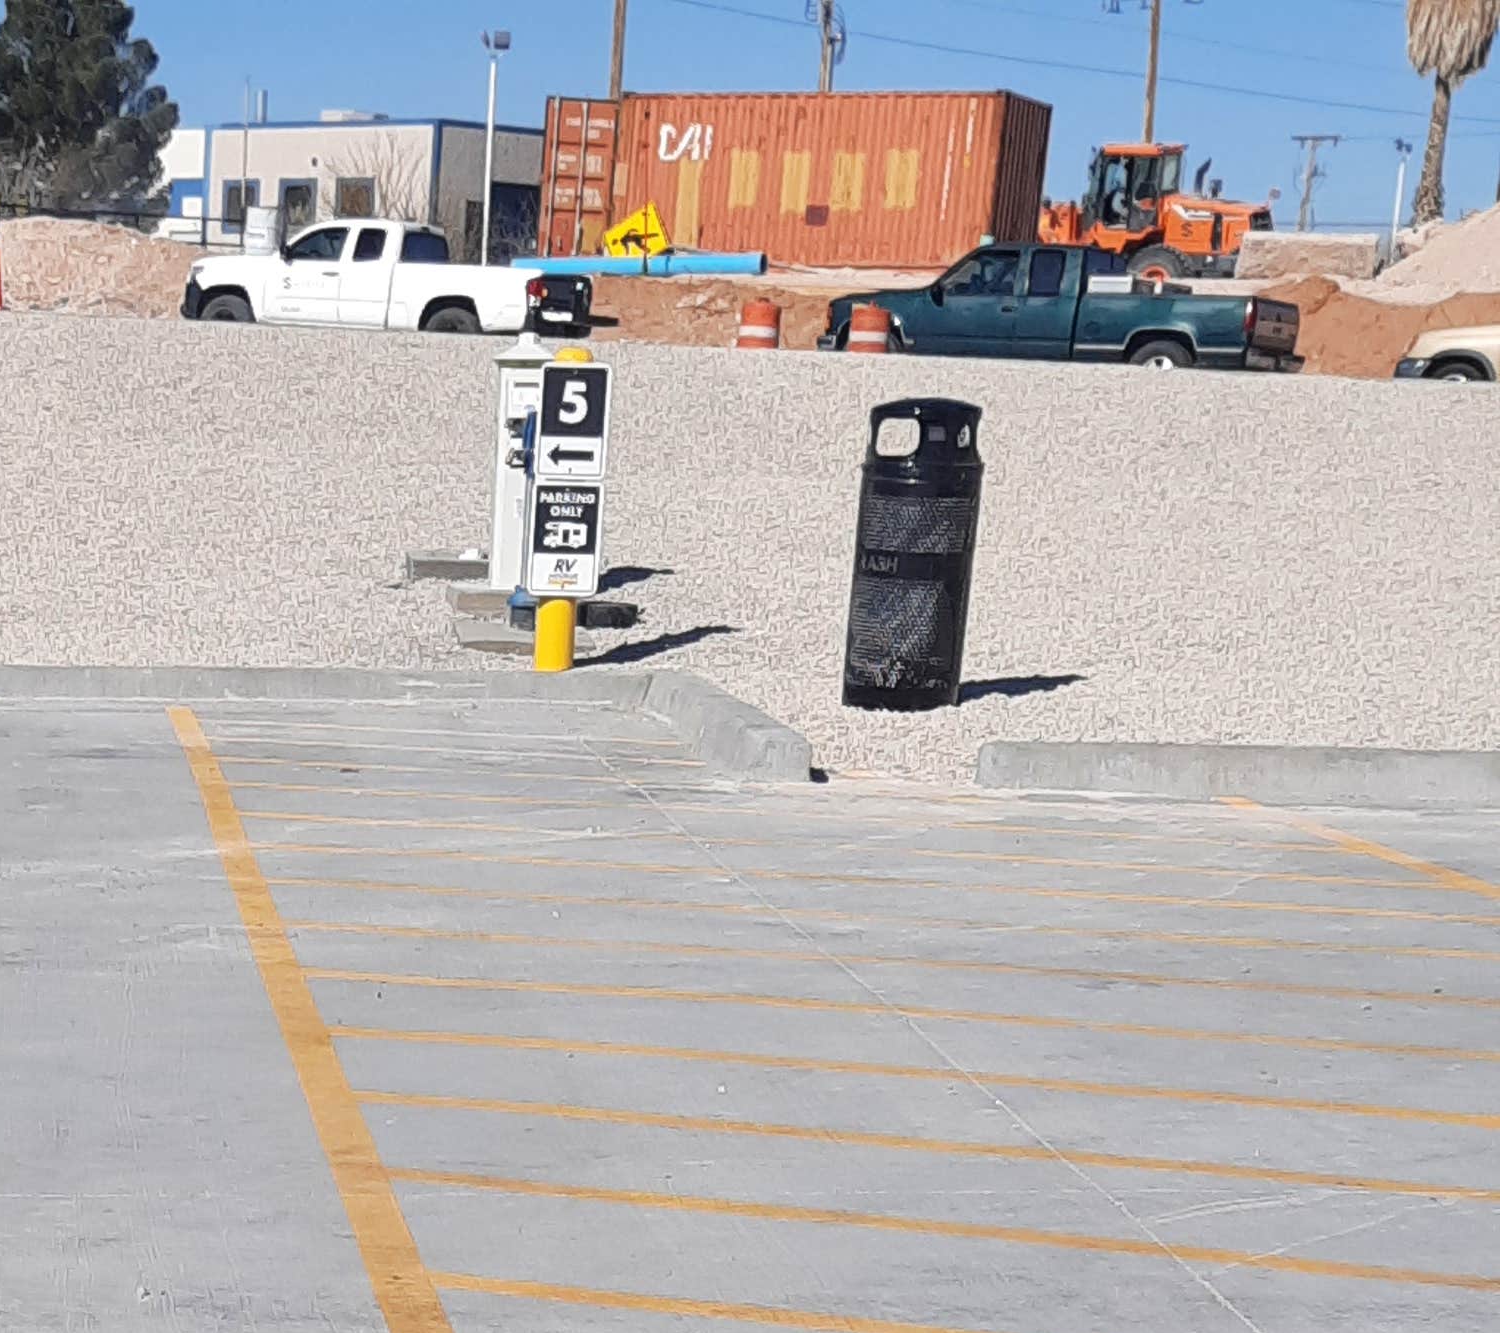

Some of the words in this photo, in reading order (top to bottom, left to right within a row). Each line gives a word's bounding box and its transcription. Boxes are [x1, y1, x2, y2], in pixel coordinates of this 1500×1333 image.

[559, 380, 588, 424] 5
[540, 492, 596, 504] PARKING
[550, 505, 583, 517] ONLY
[554, 559, 578, 572] RV
